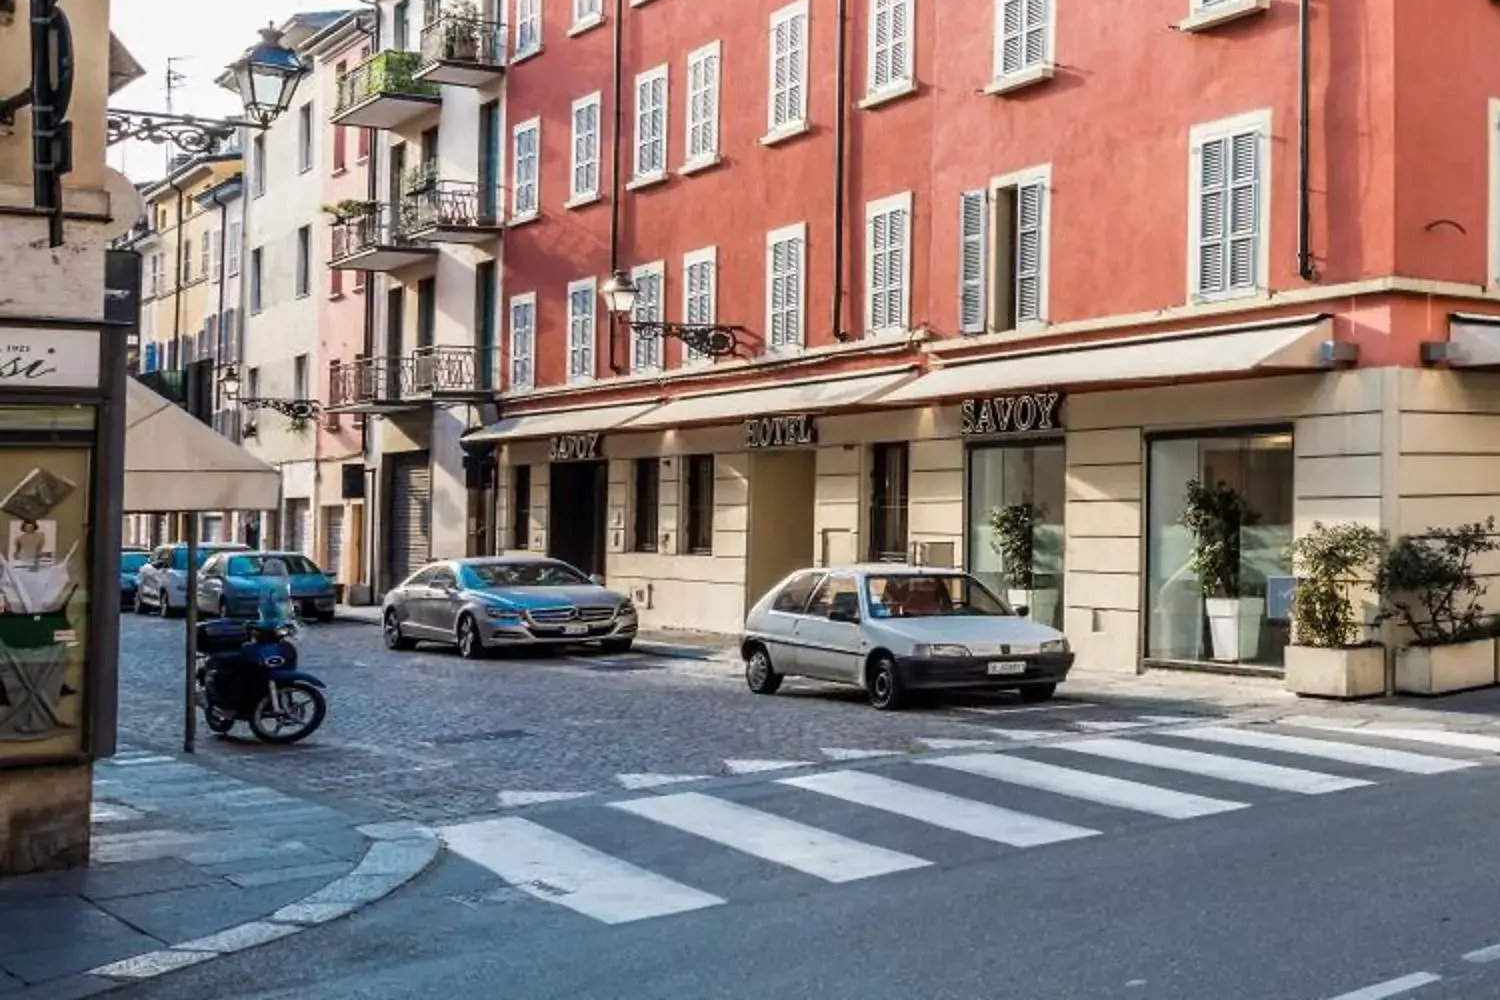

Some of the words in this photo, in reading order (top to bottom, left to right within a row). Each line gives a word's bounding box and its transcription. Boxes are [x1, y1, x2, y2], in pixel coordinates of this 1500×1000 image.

[960, 391, 1059, 434] SAVOY
[548, 431, 600, 460] SAVOY
[744, 414, 811, 447] HOTEL
